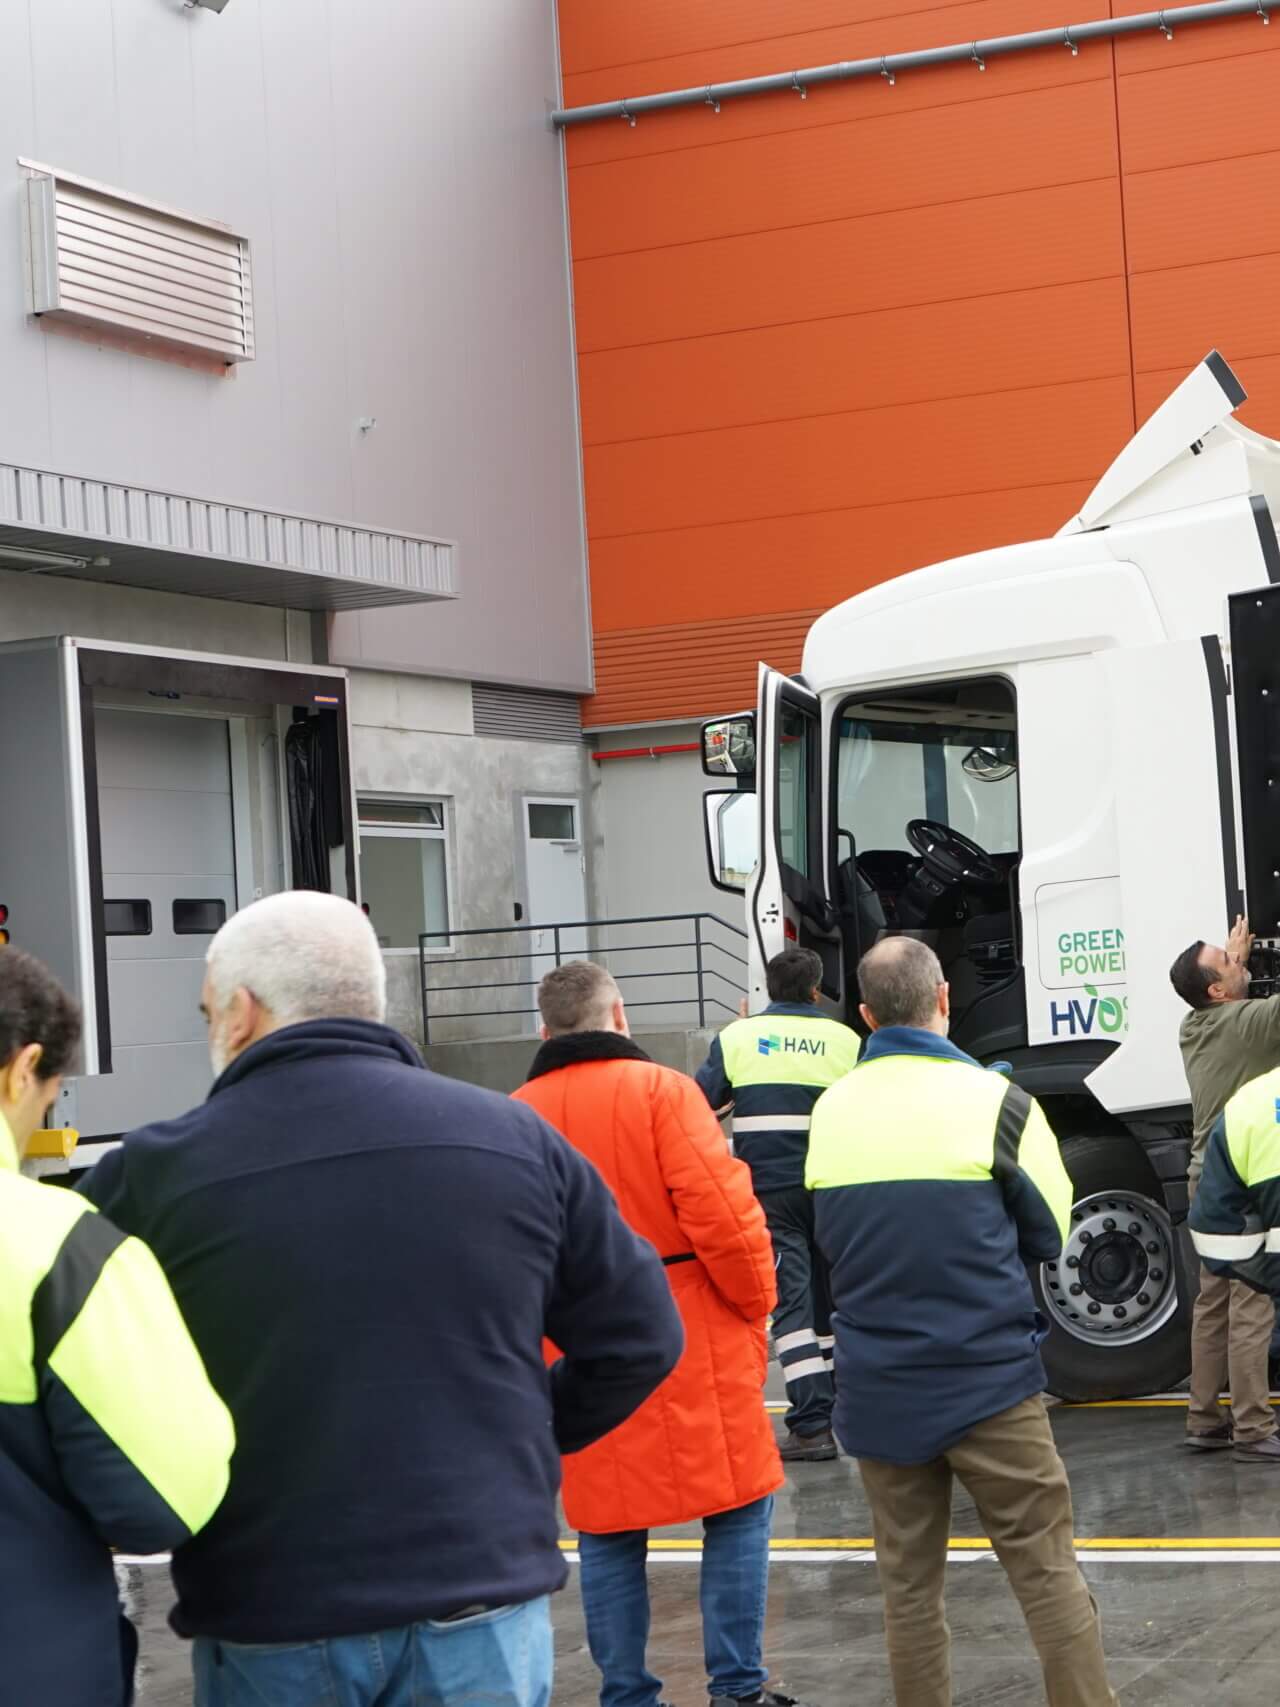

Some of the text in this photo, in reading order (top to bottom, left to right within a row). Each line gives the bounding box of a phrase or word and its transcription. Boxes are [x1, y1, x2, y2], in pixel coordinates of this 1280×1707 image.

[1060, 951, 1126, 976] POWE
[1050, 996, 1123, 1036] HVO
[784, 1036, 825, 1056] HAVI
